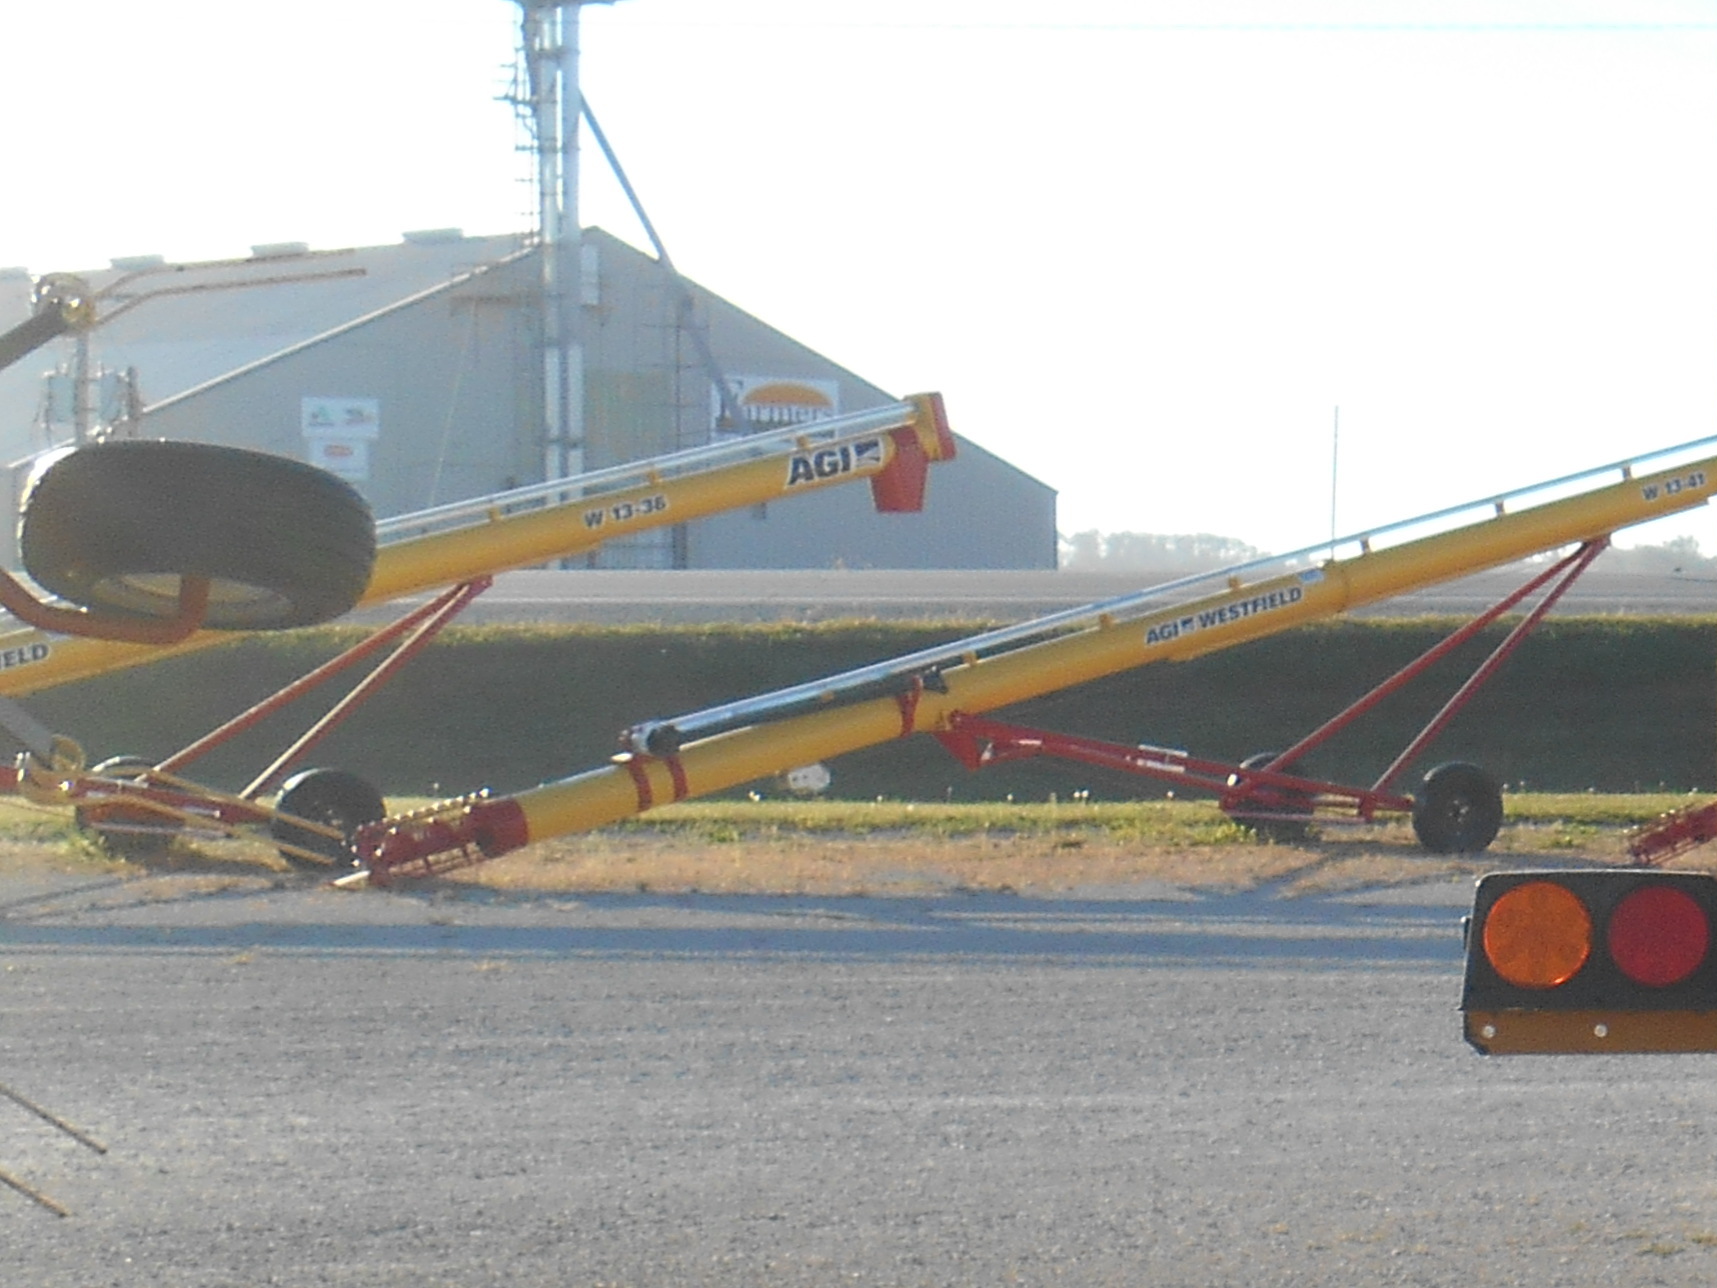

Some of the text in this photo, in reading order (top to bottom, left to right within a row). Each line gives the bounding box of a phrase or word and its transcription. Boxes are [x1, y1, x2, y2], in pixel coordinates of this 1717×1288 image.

[787, 446, 850, 486] AGI
[1642, 485, 1658, 501] W
[583, 512, 603, 529] W
[1146, 587, 1302, 644] AGI WESTFIELD
[0, 644, 49, 670] ELD
